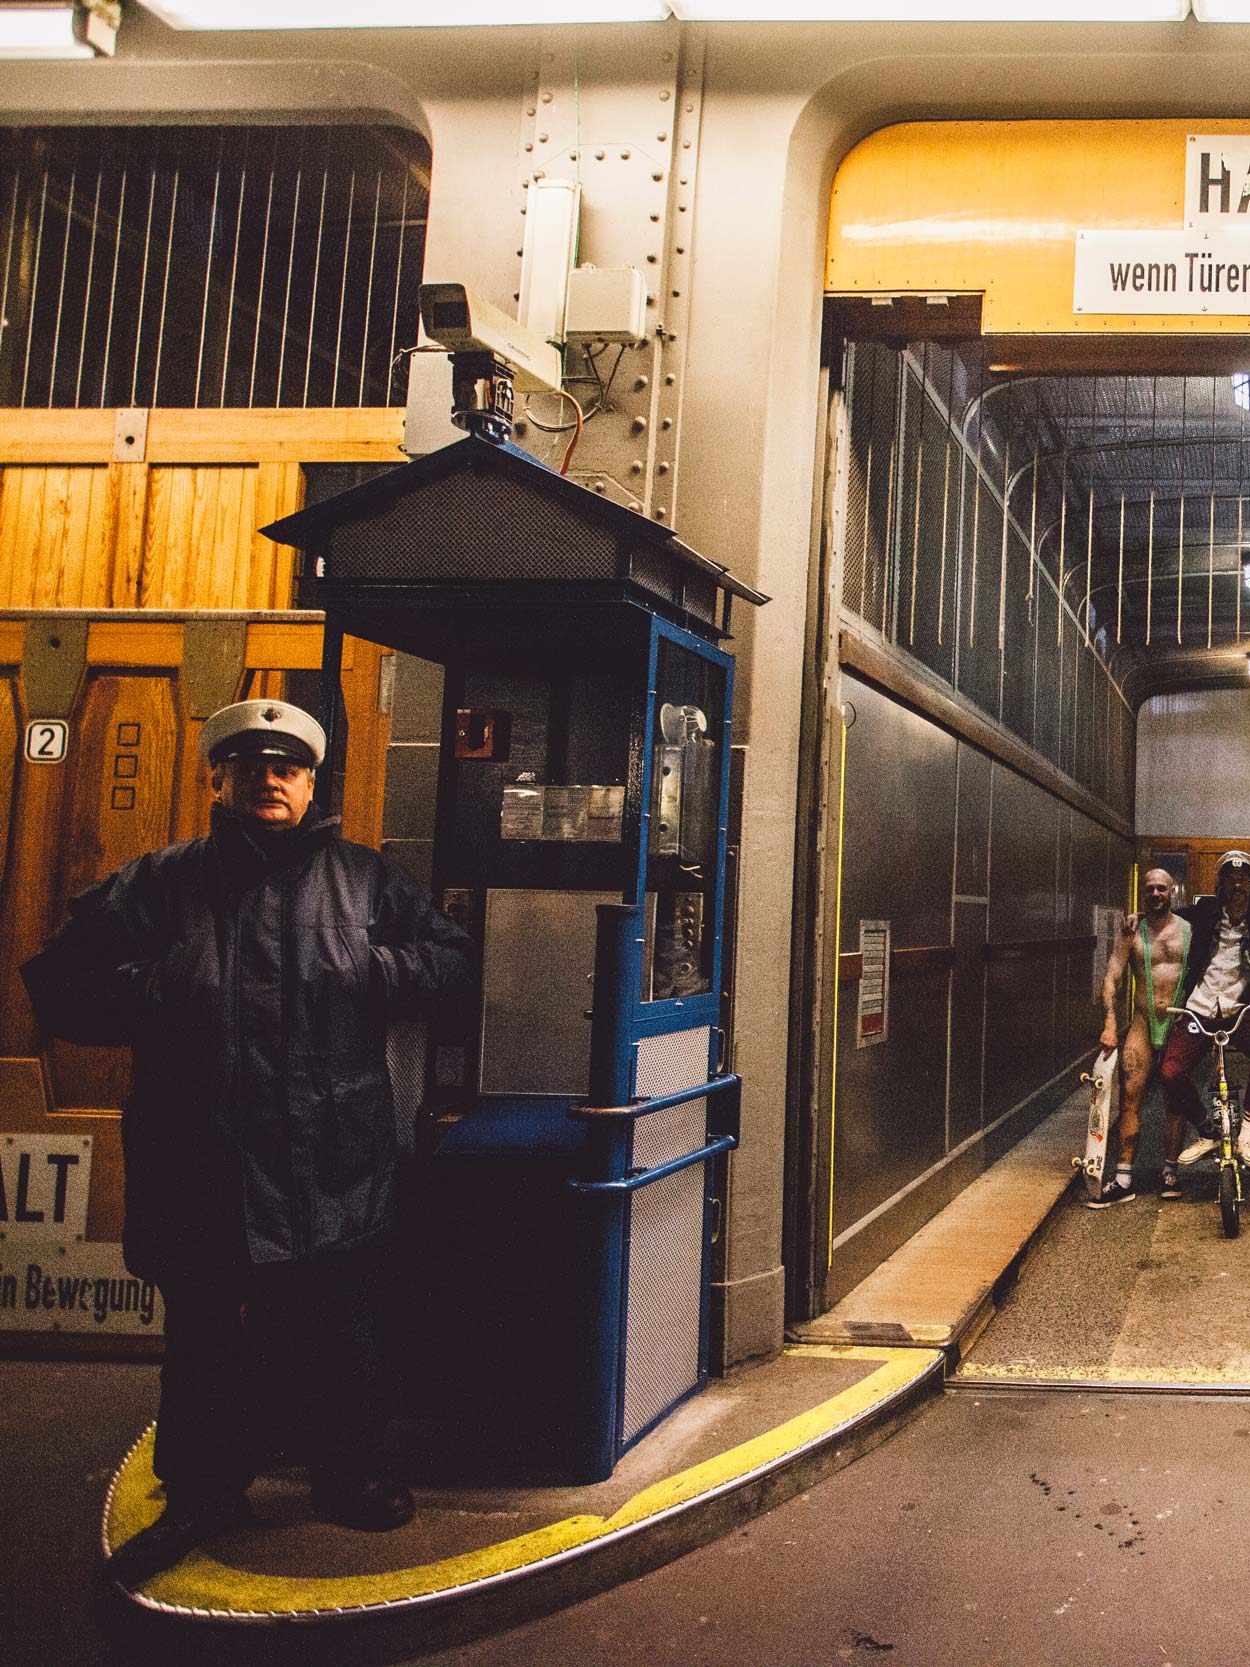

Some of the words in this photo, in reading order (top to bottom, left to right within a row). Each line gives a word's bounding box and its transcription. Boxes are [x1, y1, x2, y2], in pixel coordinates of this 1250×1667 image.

[1109, 262, 1177, 292] wenn
[38, 727, 56, 756] 2
[25, 1262, 155, 1327] Bewegung
